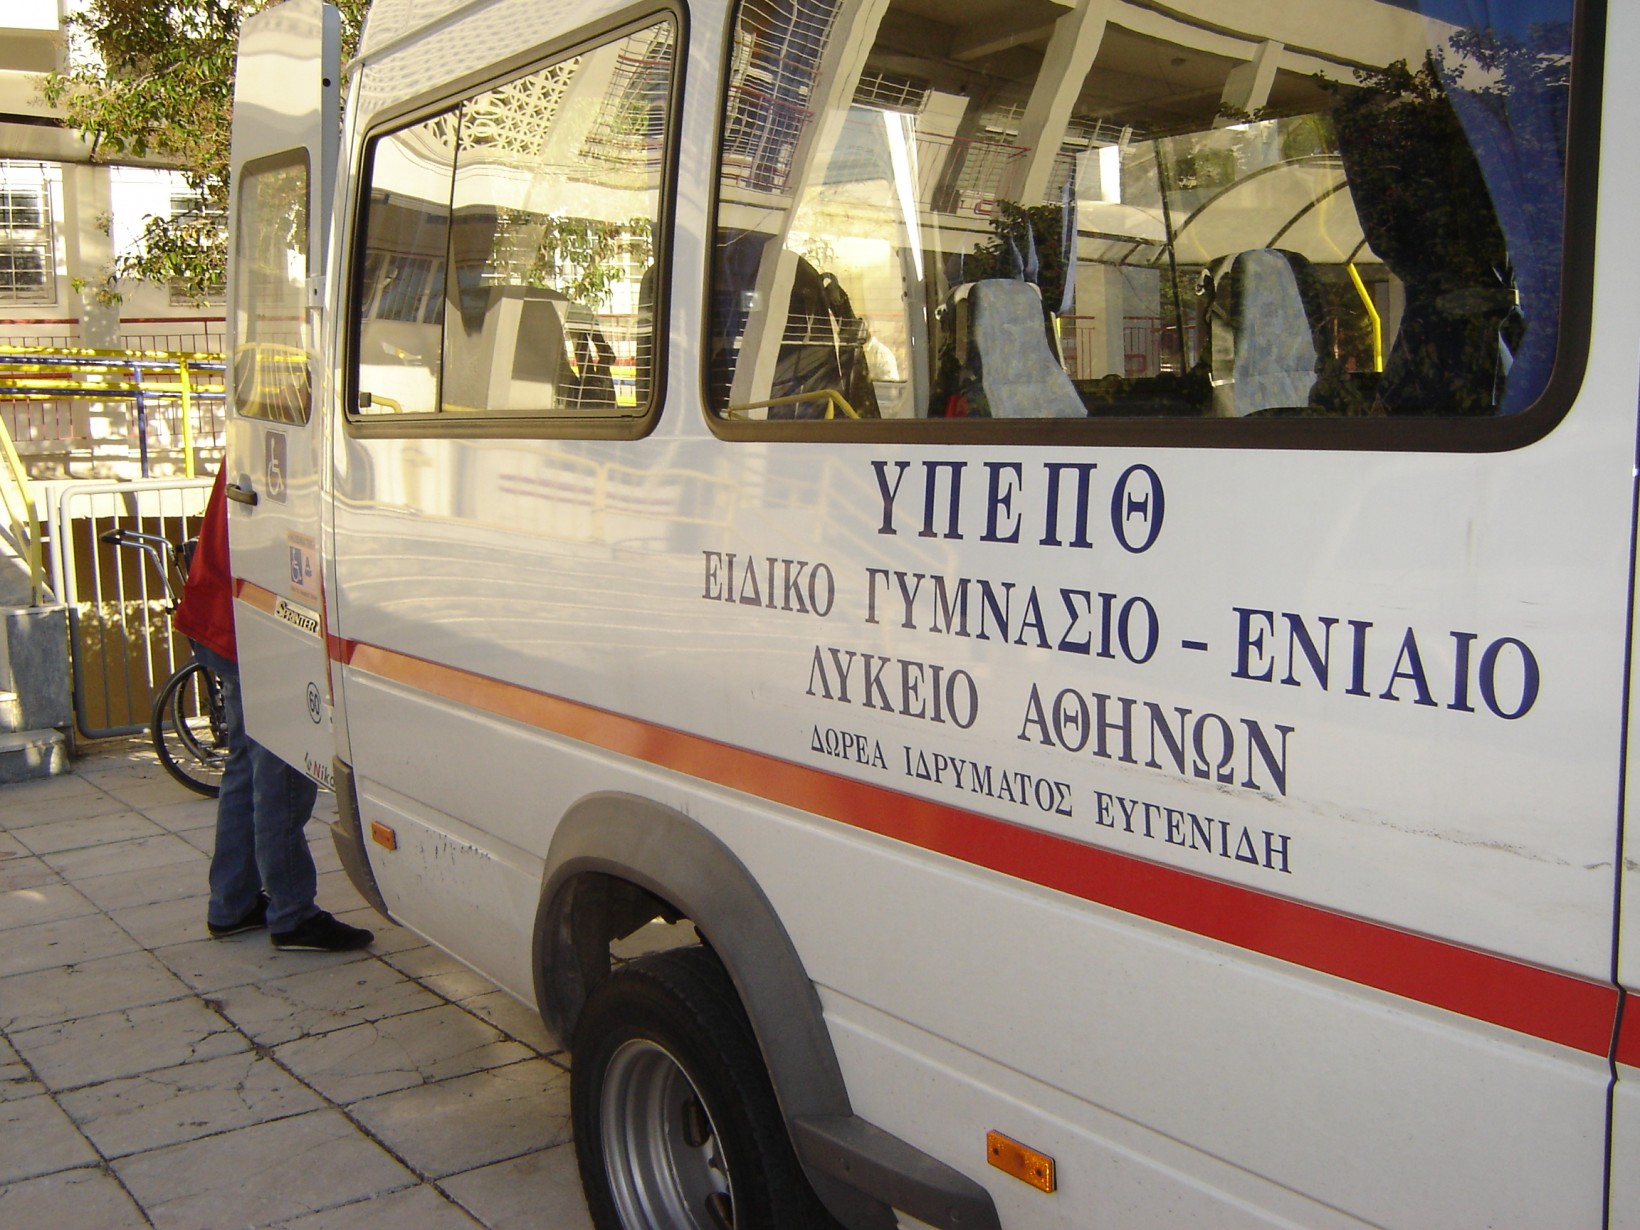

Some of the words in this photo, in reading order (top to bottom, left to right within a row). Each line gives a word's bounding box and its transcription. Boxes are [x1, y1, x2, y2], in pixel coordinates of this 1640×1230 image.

[870, 461, 1166, 555] ΥΠΕΠΘ
[309, 691, 320, 715] 60
[701, 549, 836, 618] ΕΙΔΙΚΟ
[865, 567, 1160, 665] ΓΥΜΝΑΣΙΟ
[1231, 606, 1541, 721] ΕΝΙΑΙΟ
[805, 645, 979, 730] ΛΥΚΕΙΟ
[1016, 682, 1296, 797] ΑΘΗΝΩΝ
[810, 724, 889, 771] ΔΩΡΕΑ
[903, 745, 1073, 818] ΙΔΡΥΜΑΤΟΣ
[1092, 790, 1293, 875] ΕΥΓΕΝΙΔΗ
